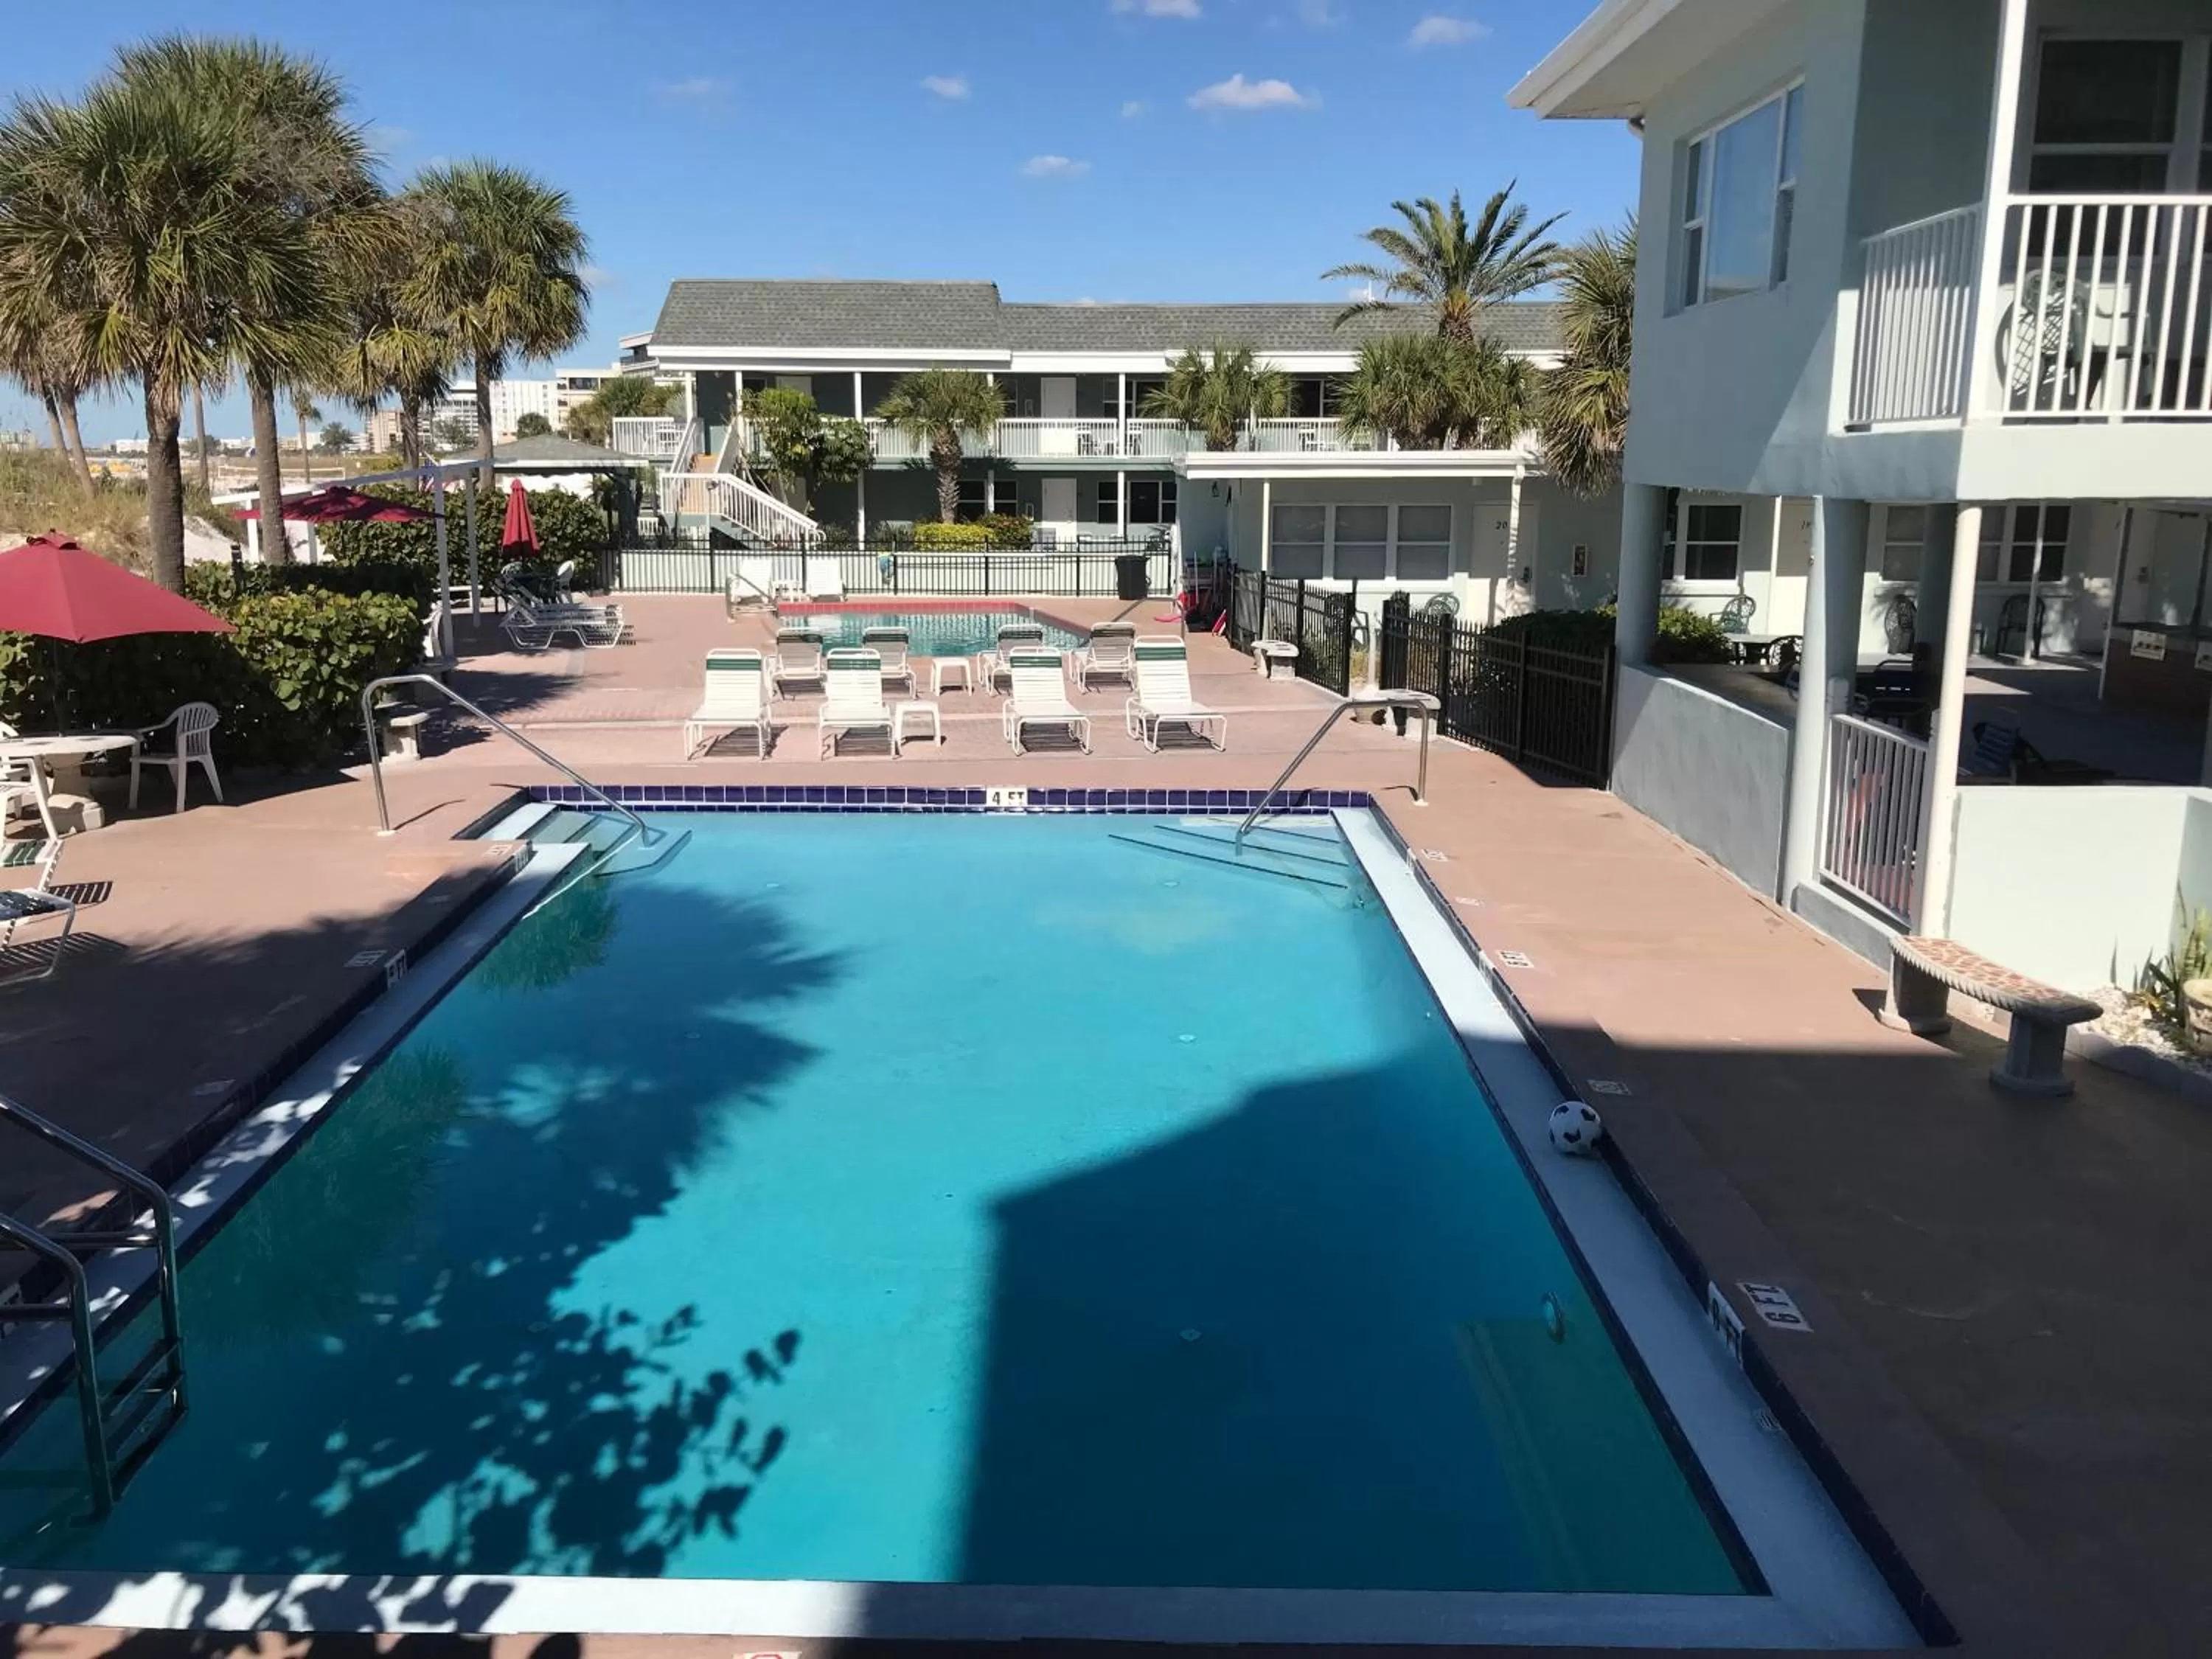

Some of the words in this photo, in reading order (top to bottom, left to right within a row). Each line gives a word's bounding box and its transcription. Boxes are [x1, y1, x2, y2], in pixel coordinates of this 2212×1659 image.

[1495, 521, 1508, 530] 20
[992, 792, 1000, 805] 4
[1008, 792, 1024, 804] FT
[1764, 1312, 1801, 1324] 6
